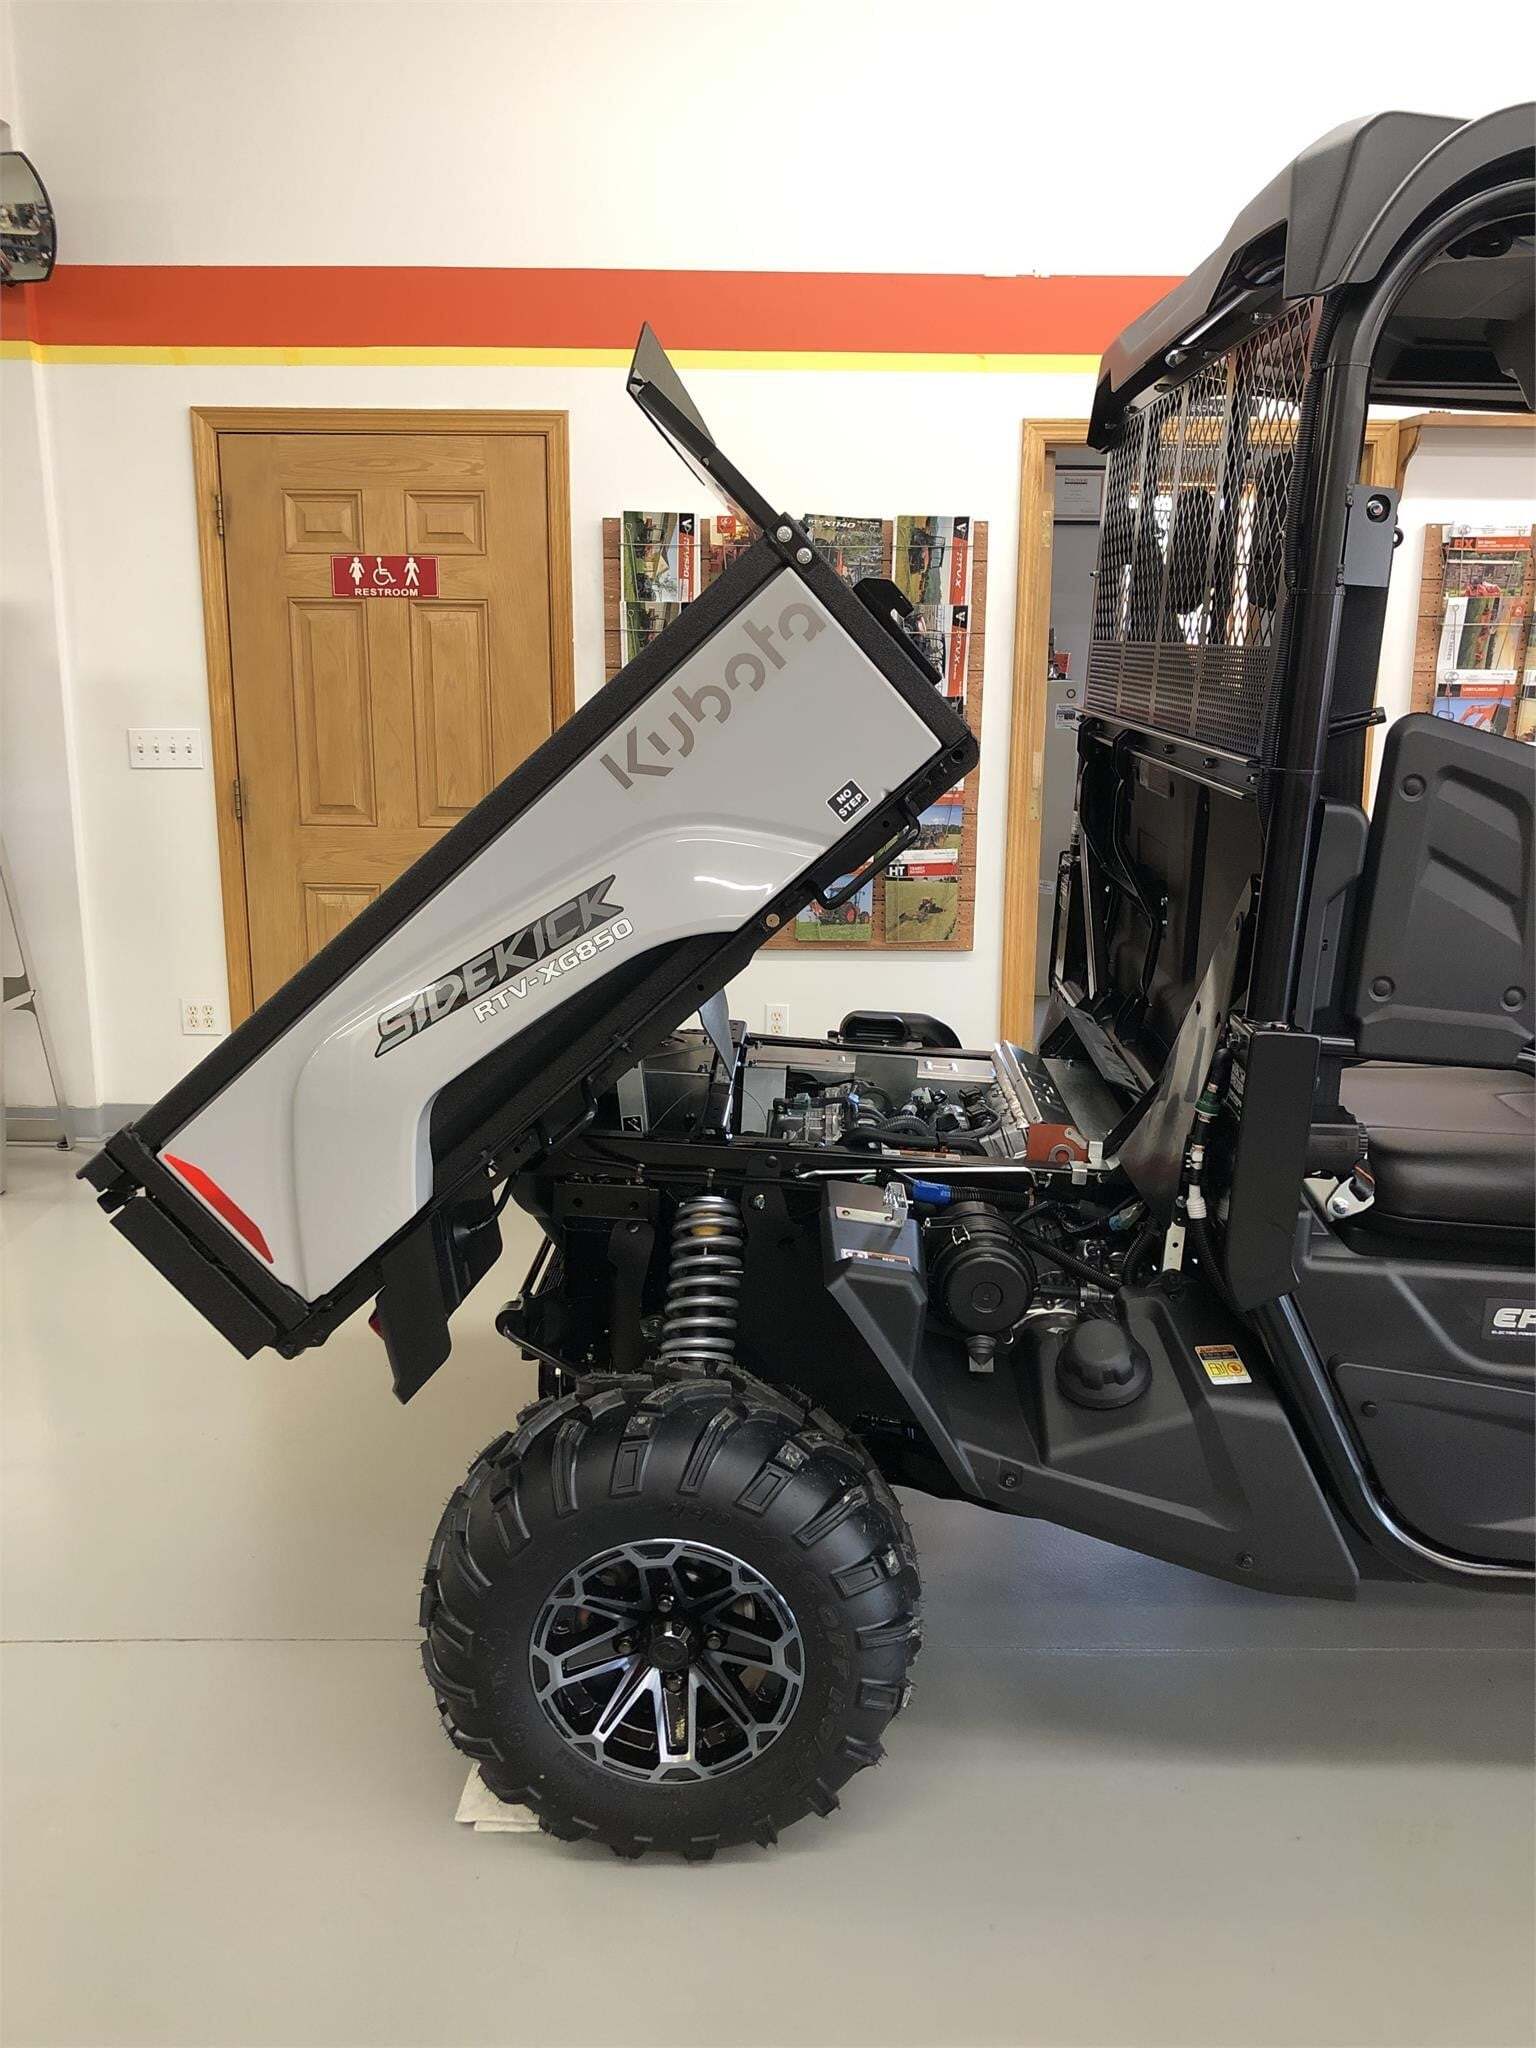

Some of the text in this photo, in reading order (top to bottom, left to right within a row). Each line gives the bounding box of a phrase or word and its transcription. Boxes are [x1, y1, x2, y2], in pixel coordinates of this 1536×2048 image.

[354, 588, 419, 597] RESTROOM
[600, 602, 827, 790] Kubota
[836, 789, 852, 804] NO
[838, 793, 863, 817] STEP
[889, 866, 905, 876] HT
[374, 874, 624, 1058] SIDEKICK
[473, 917, 634, 1023] RTV-XG850
